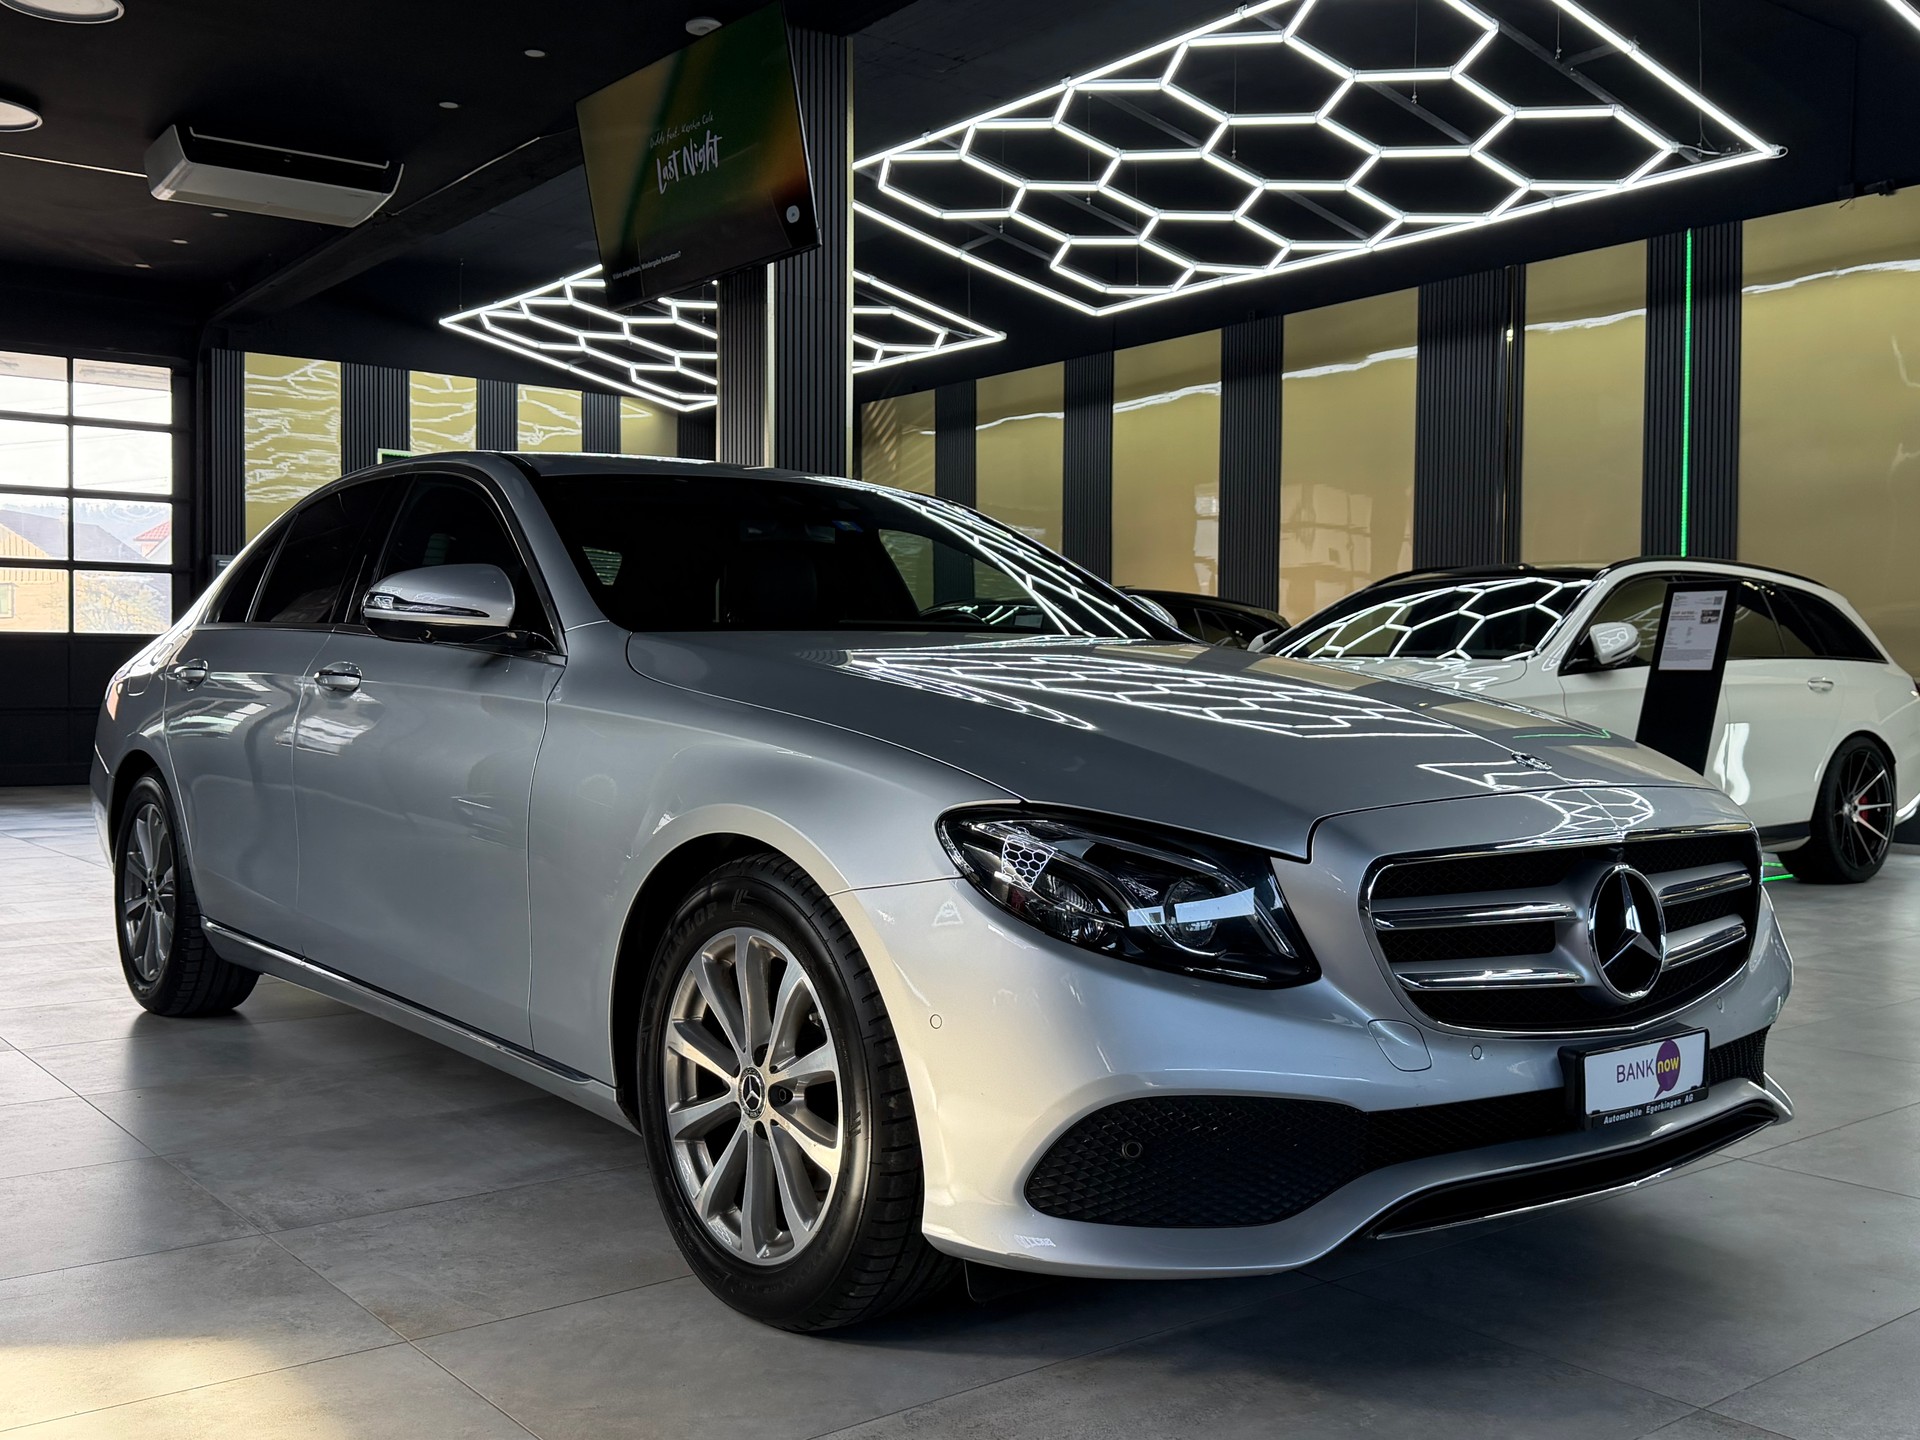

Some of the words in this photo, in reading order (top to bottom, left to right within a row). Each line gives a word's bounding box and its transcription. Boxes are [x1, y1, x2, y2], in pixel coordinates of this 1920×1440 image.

[656, 149, 681, 195] Last
[682, 129, 723, 177] Night
[655, 901, 719, 983] DUNLOP
[1616, 1058, 1655, 1083] BANK
[1657, 1055, 1680, 1074] now
[1603, 1107, 1643, 1125] Automobile
[1646, 1098, 1682, 1115] Egerkingen
[1684, 1093, 1694, 1103] AG
